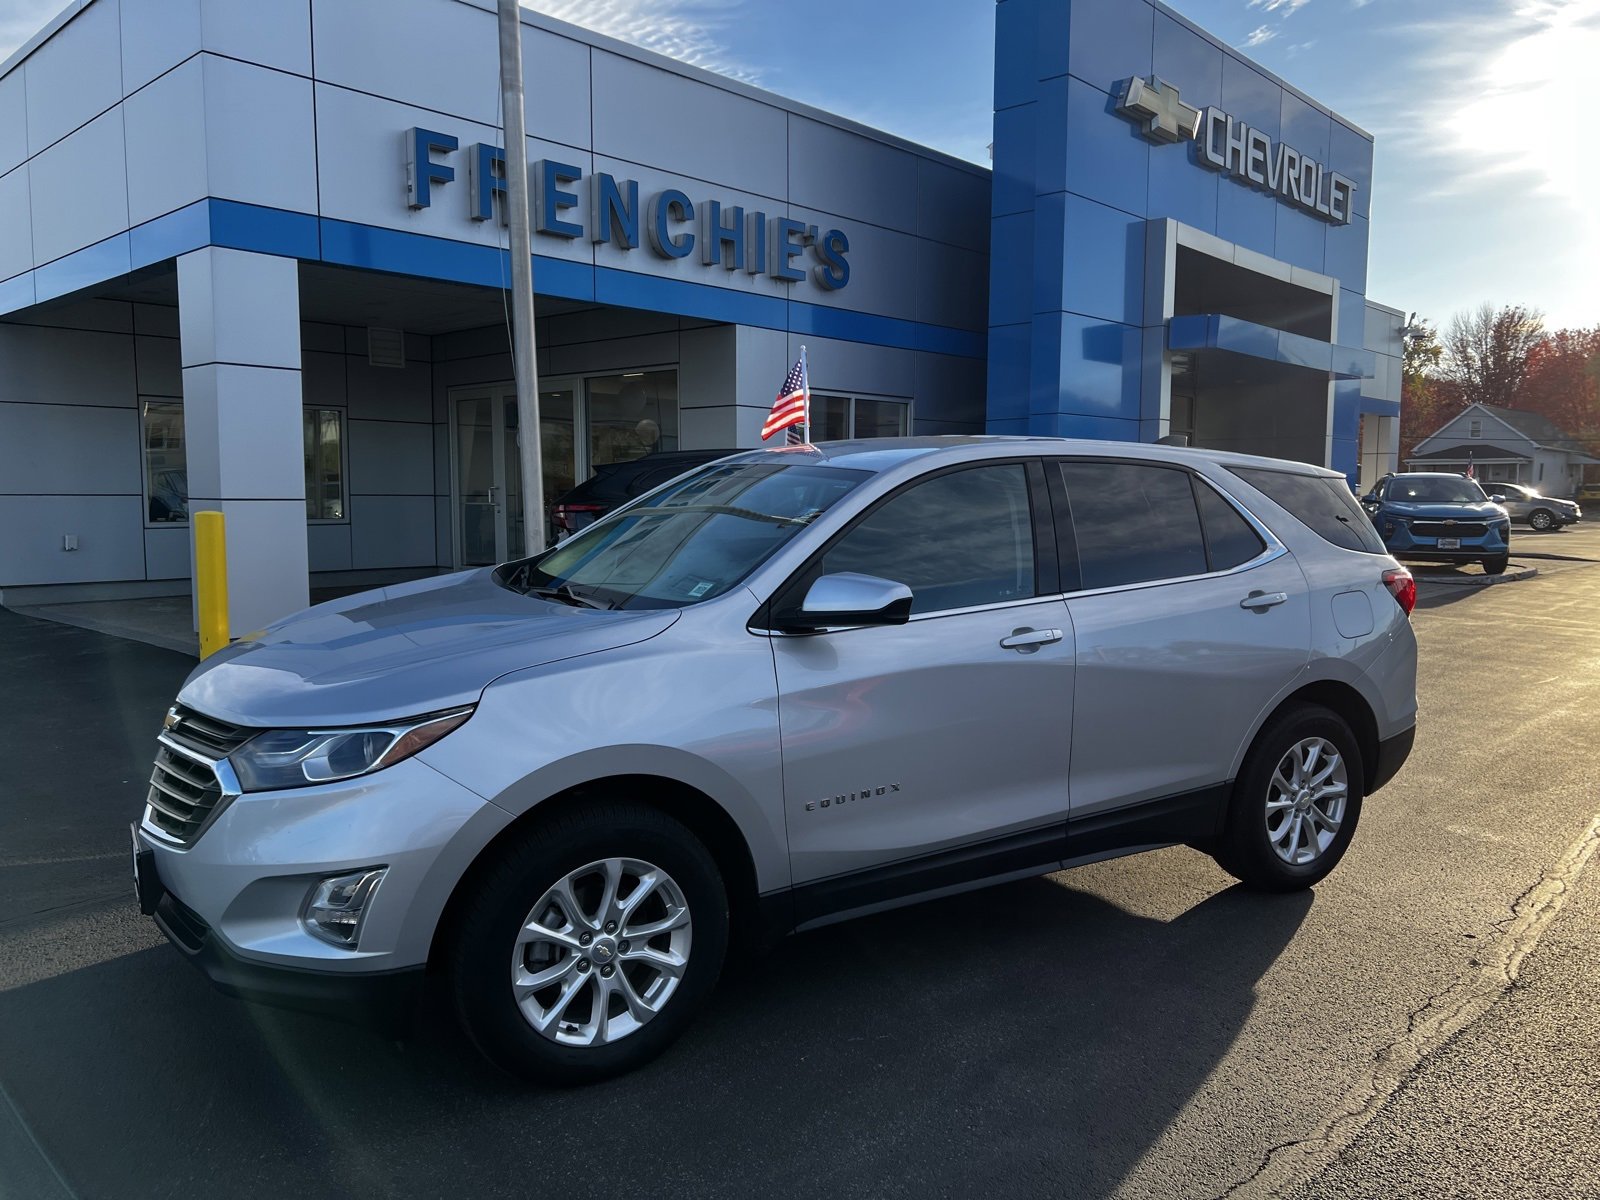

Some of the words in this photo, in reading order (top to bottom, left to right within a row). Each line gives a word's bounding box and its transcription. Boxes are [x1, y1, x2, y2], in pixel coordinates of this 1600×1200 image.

[405, 126, 850, 291] FRENCHIE'S
[1203, 105, 1358, 226] CHEVROLET
[804, 782, 901, 812] EQUINOX
